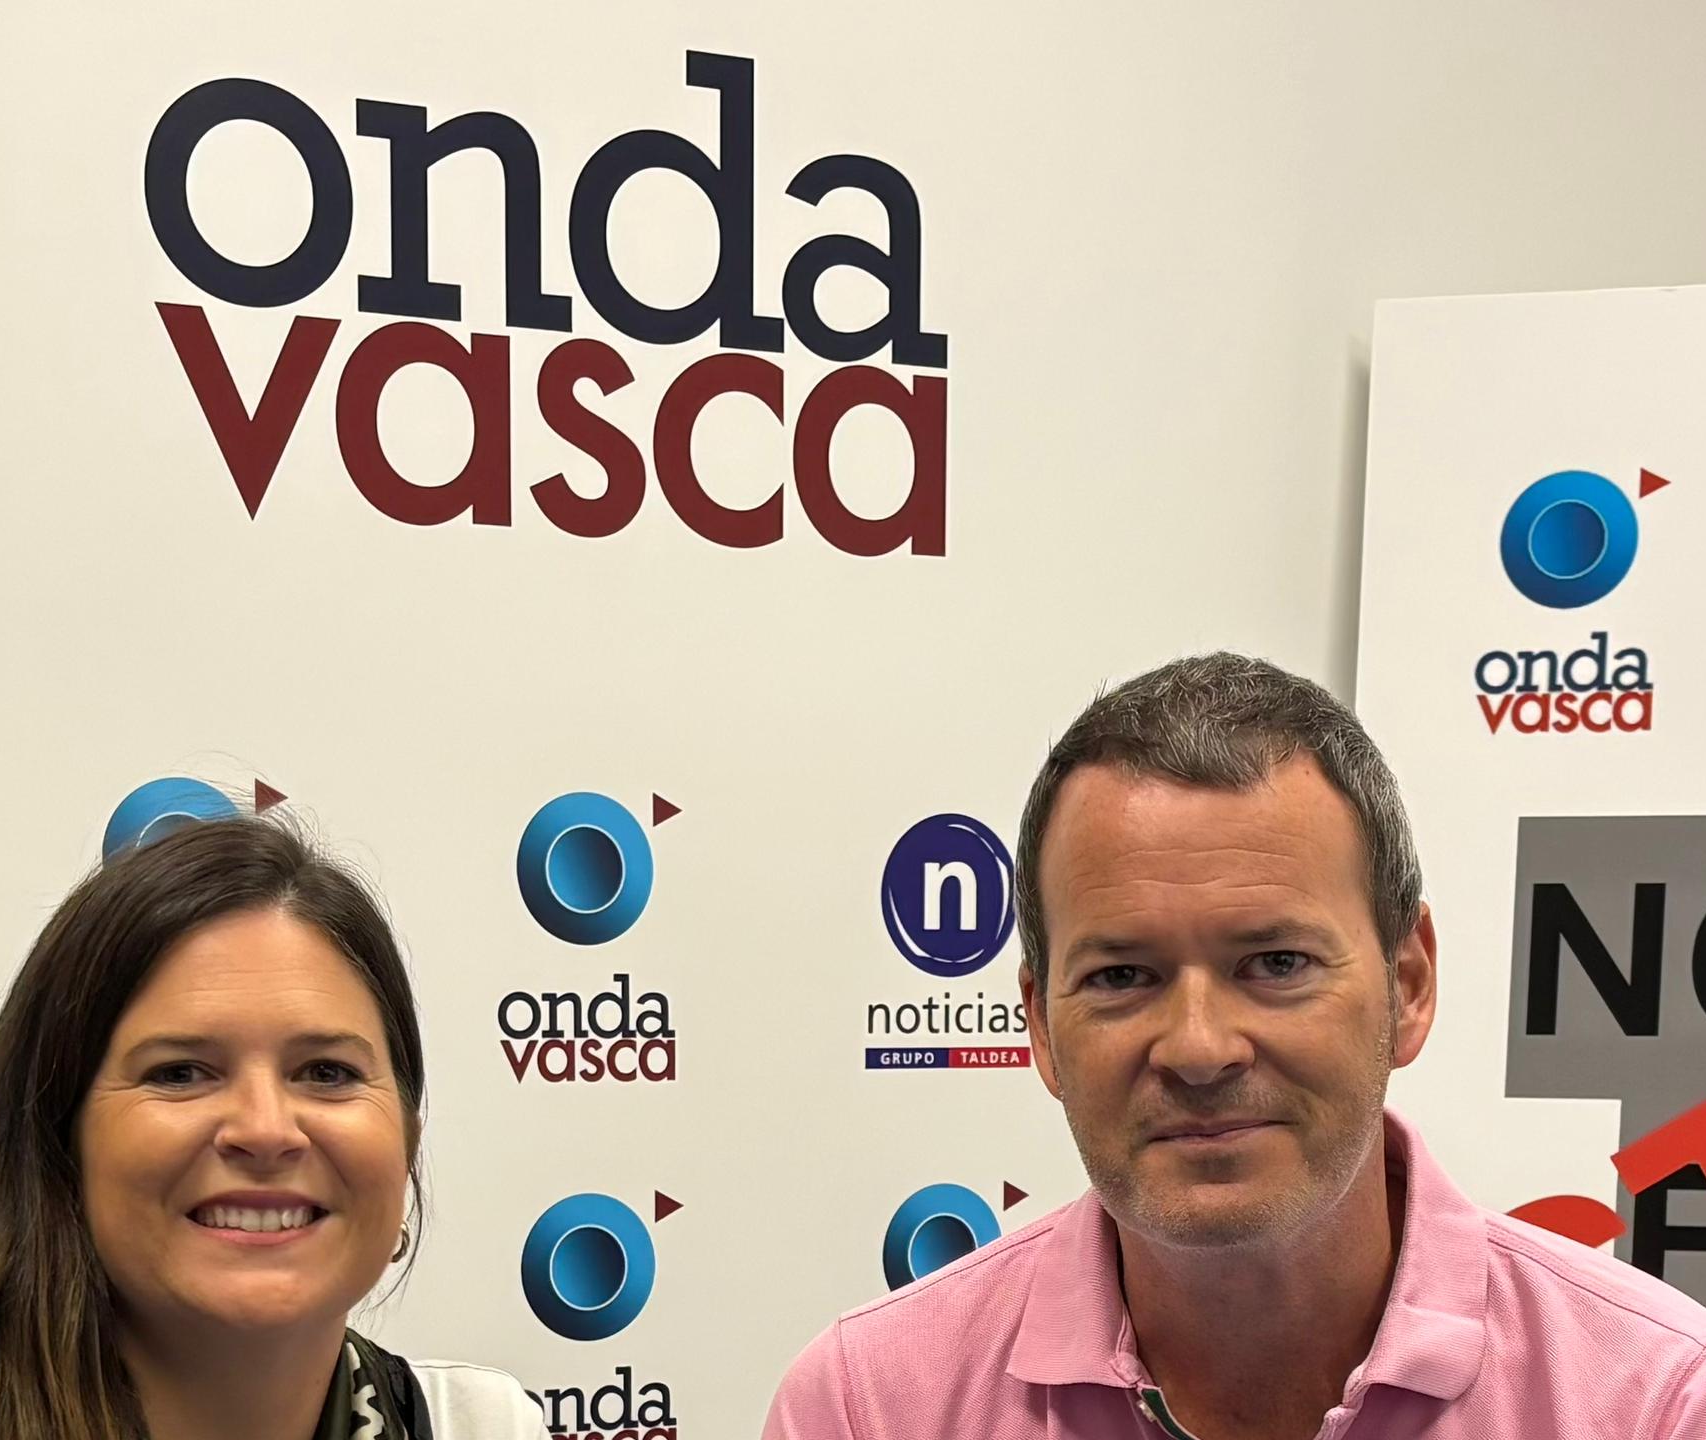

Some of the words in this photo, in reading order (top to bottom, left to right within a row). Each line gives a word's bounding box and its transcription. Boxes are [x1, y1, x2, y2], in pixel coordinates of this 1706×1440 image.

[145, 50, 948, 368] onda
[155, 302, 948, 557] vasca
[1474, 631, 1652, 696] onda
[1475, 688, 1654, 734] vasca
[923, 861, 978, 931] n
[498, 973, 675, 1039] onda
[867, 993, 1028, 1034] noticias
[500, 1037, 677, 1084] vasca
[880, 1051, 935, 1067] GRUPO
[960, 1050, 1021, 1066] TALDEA
[523, 1366, 677, 1432] nda
